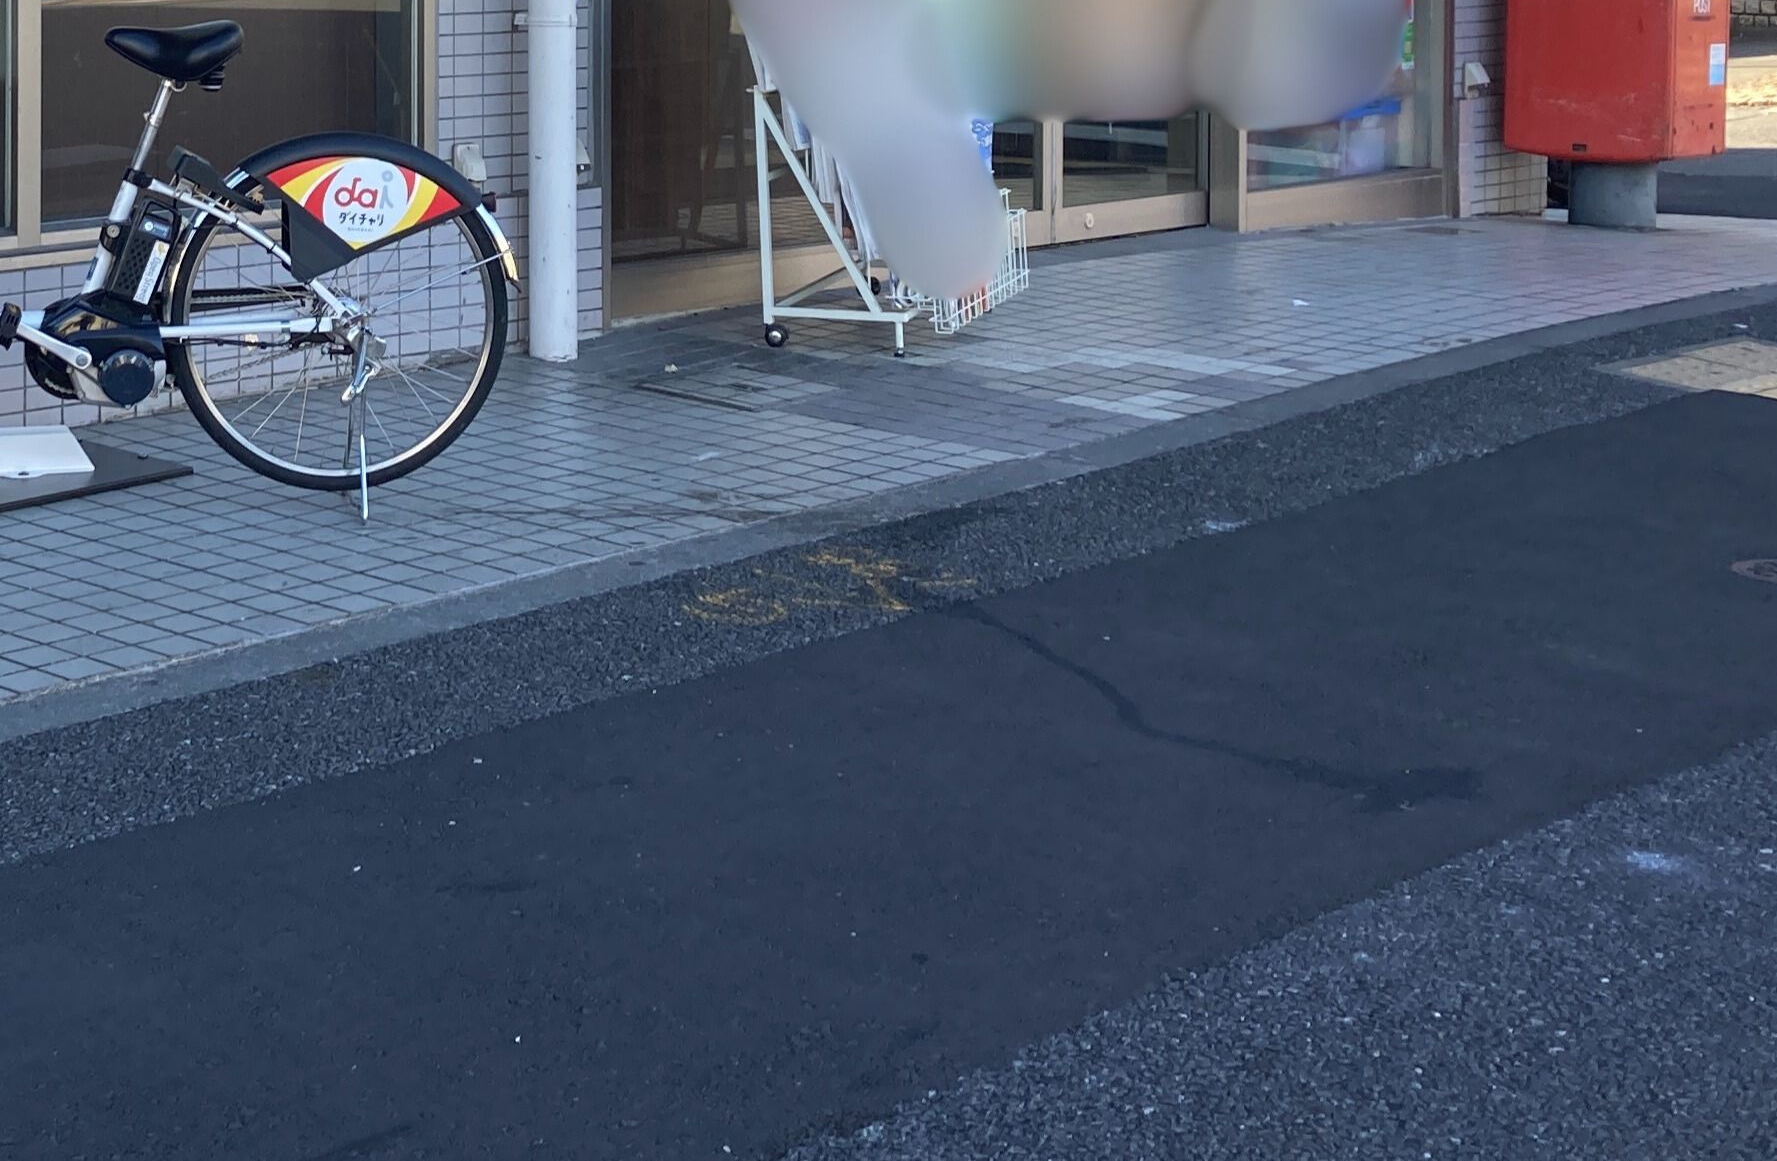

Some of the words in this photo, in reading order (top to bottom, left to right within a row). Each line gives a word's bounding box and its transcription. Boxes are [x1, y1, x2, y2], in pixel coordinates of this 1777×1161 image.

[334, 169, 394, 210] dai
[338, 211, 385, 227] ダイチャリ
